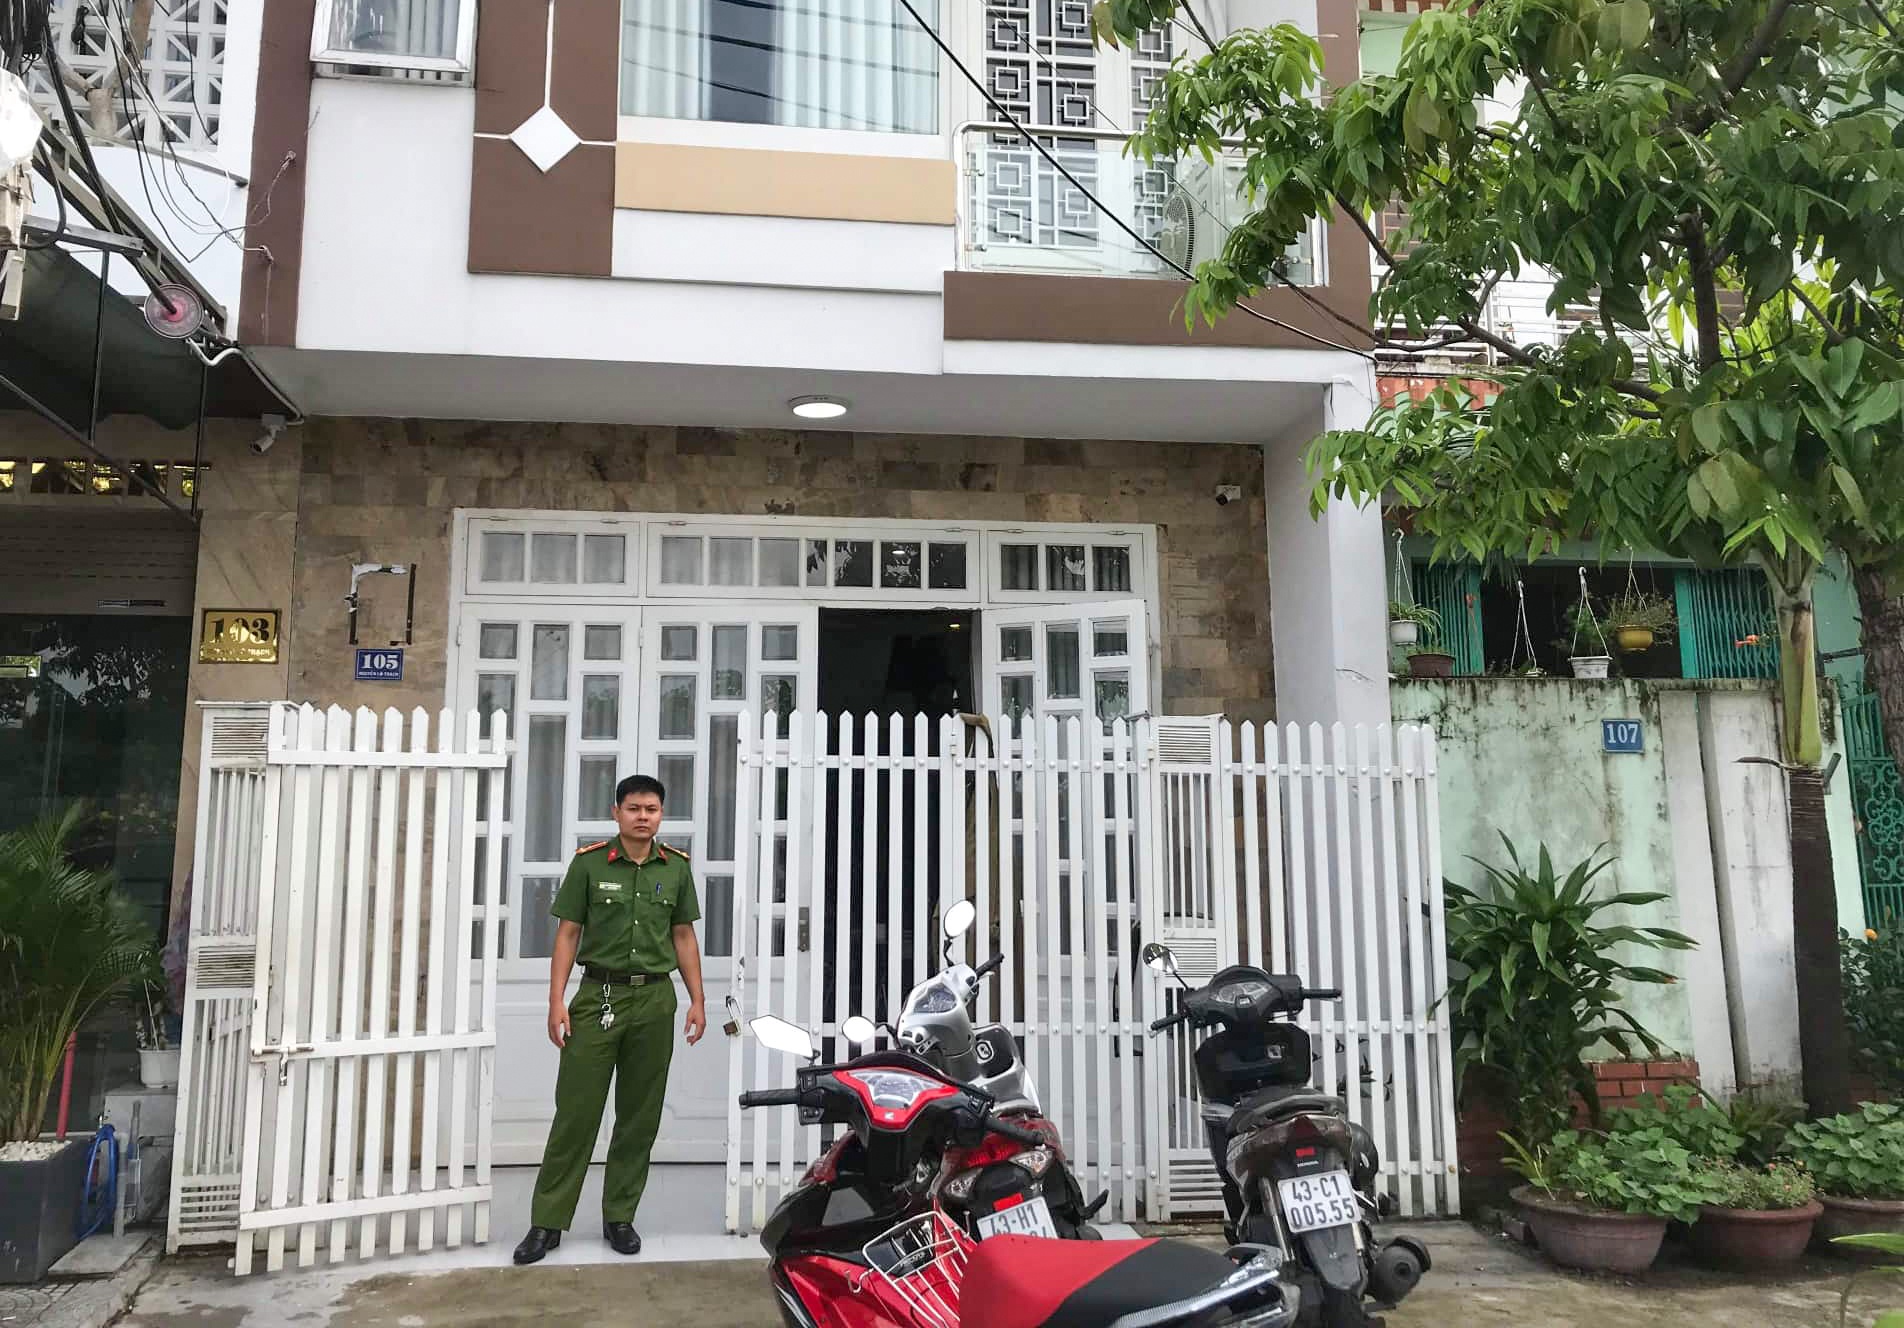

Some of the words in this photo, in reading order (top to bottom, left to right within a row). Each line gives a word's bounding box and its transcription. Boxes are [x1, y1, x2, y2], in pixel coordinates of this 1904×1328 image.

[209, 617, 270, 644] 103
[360, 654, 399, 670] 105
[1606, 723, 1639, 744] 107
[1291, 1175, 1341, 1202] 43-C1
[1290, 1197, 1355, 1228] 005.55
